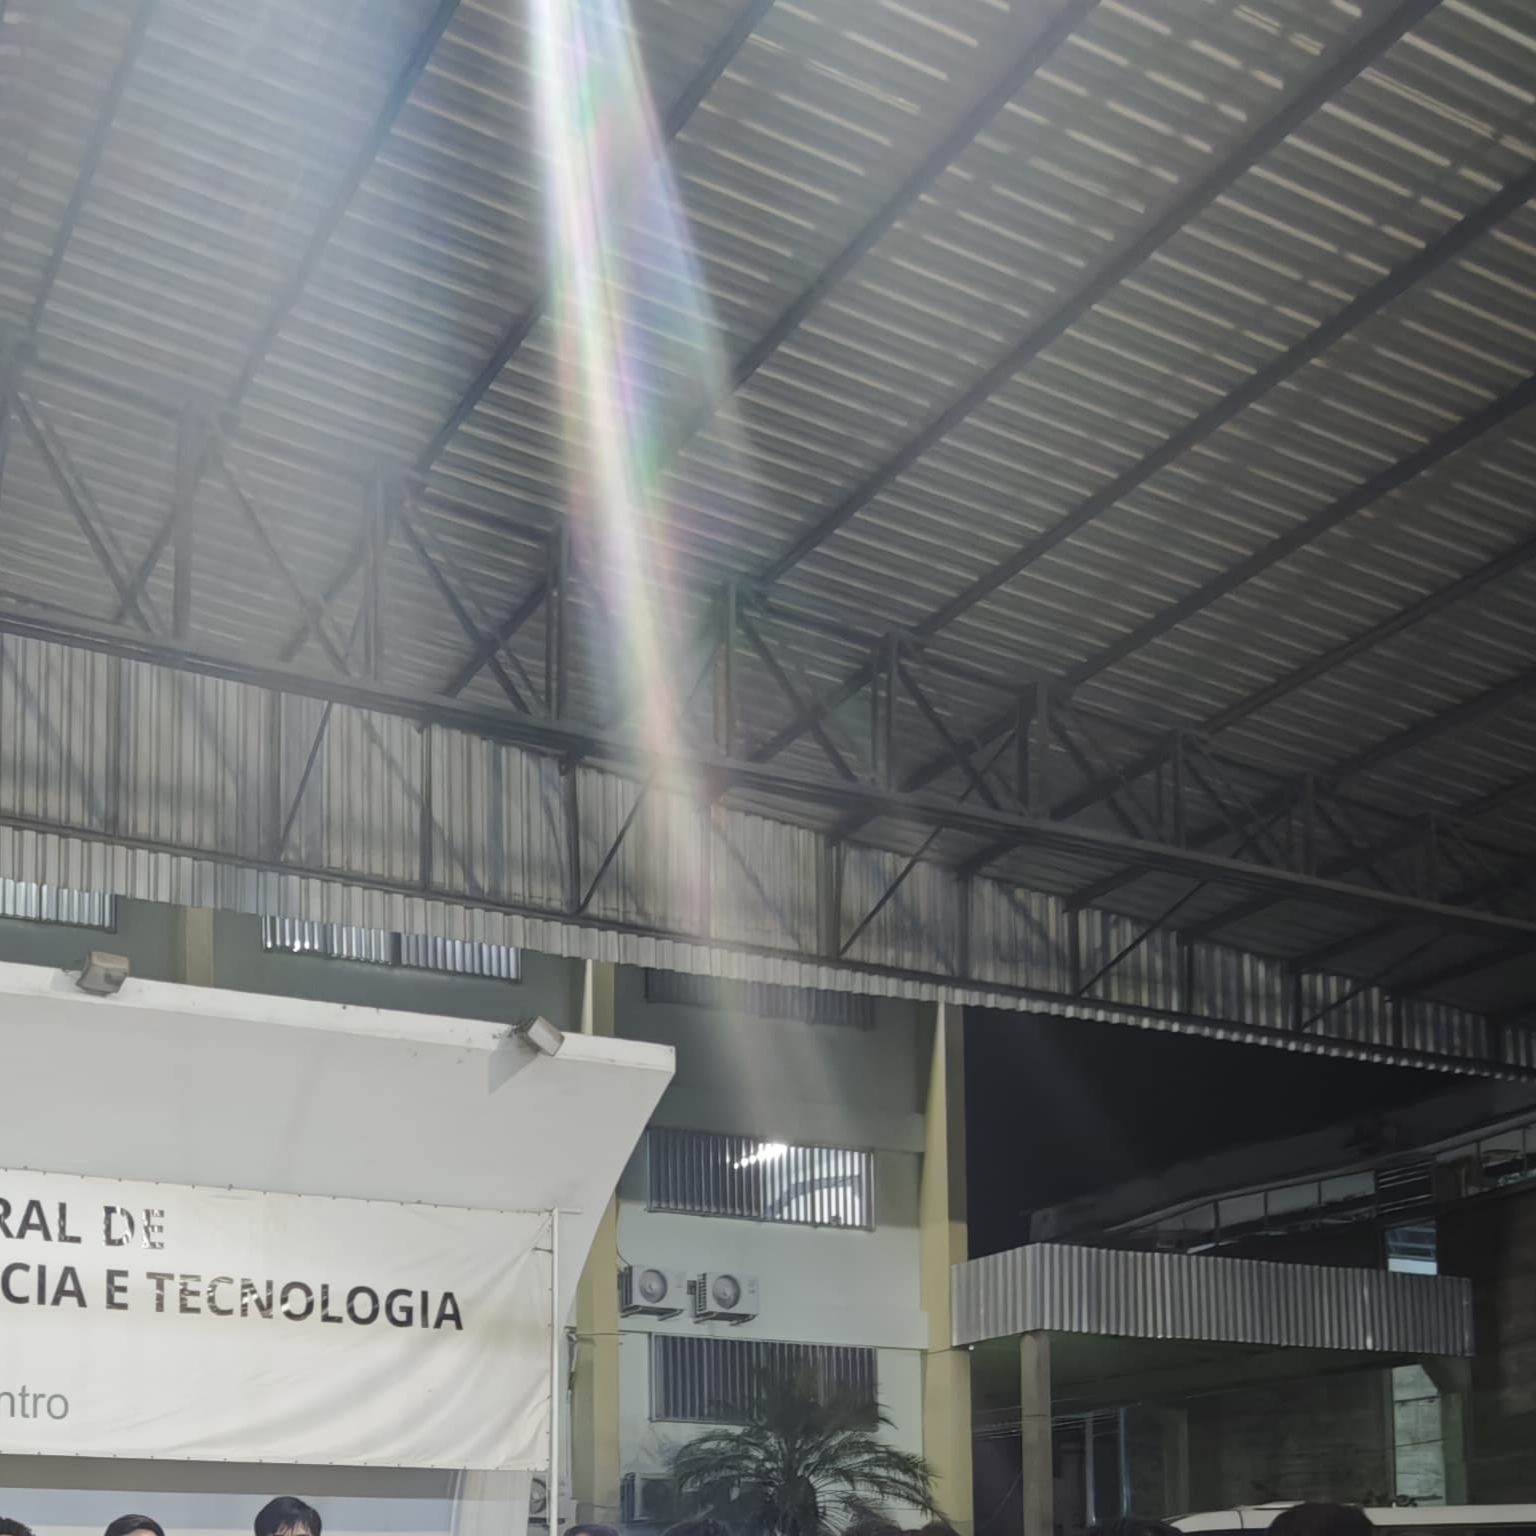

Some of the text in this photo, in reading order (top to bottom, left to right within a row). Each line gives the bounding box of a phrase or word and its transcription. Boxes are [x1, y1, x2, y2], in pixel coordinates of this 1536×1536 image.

[103, 1205, 165, 1249] DE
[105, 1269, 129, 1310] E
[146, 1271, 464, 1331] TECNOLOGIA
